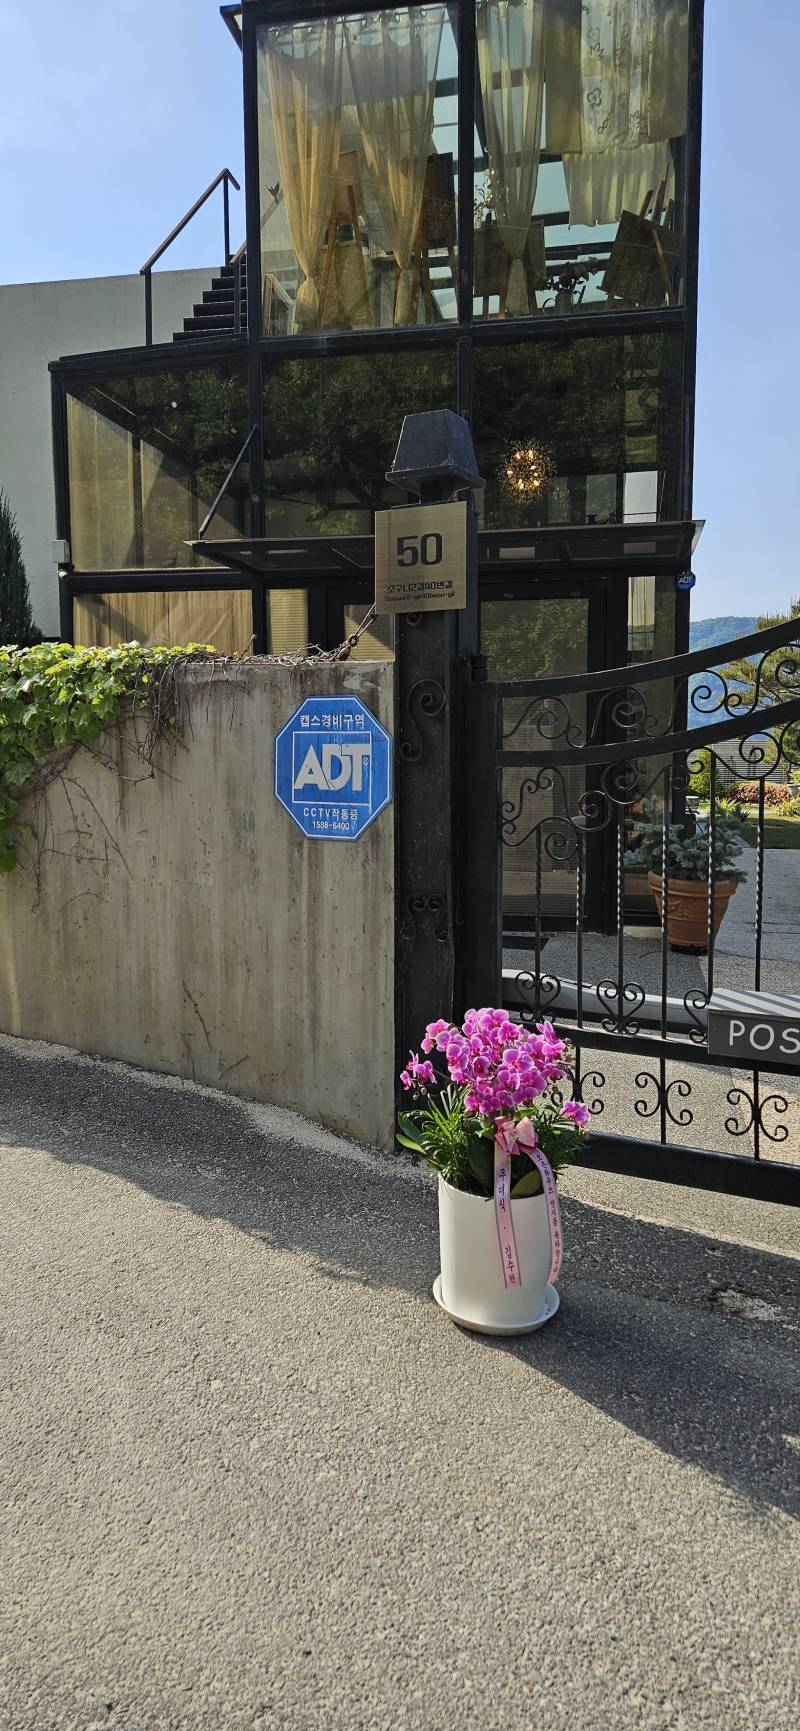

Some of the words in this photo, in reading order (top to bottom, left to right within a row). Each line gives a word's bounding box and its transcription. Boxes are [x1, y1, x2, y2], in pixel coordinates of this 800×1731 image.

[396, 532, 443, 568] 50
[300, 714, 365, 731] 캡스경비구역
[293, 743, 371, 792] ADT
[312, 821, 350, 831] 1588-6400
[504, 1244, 516, 1284] 김수현
